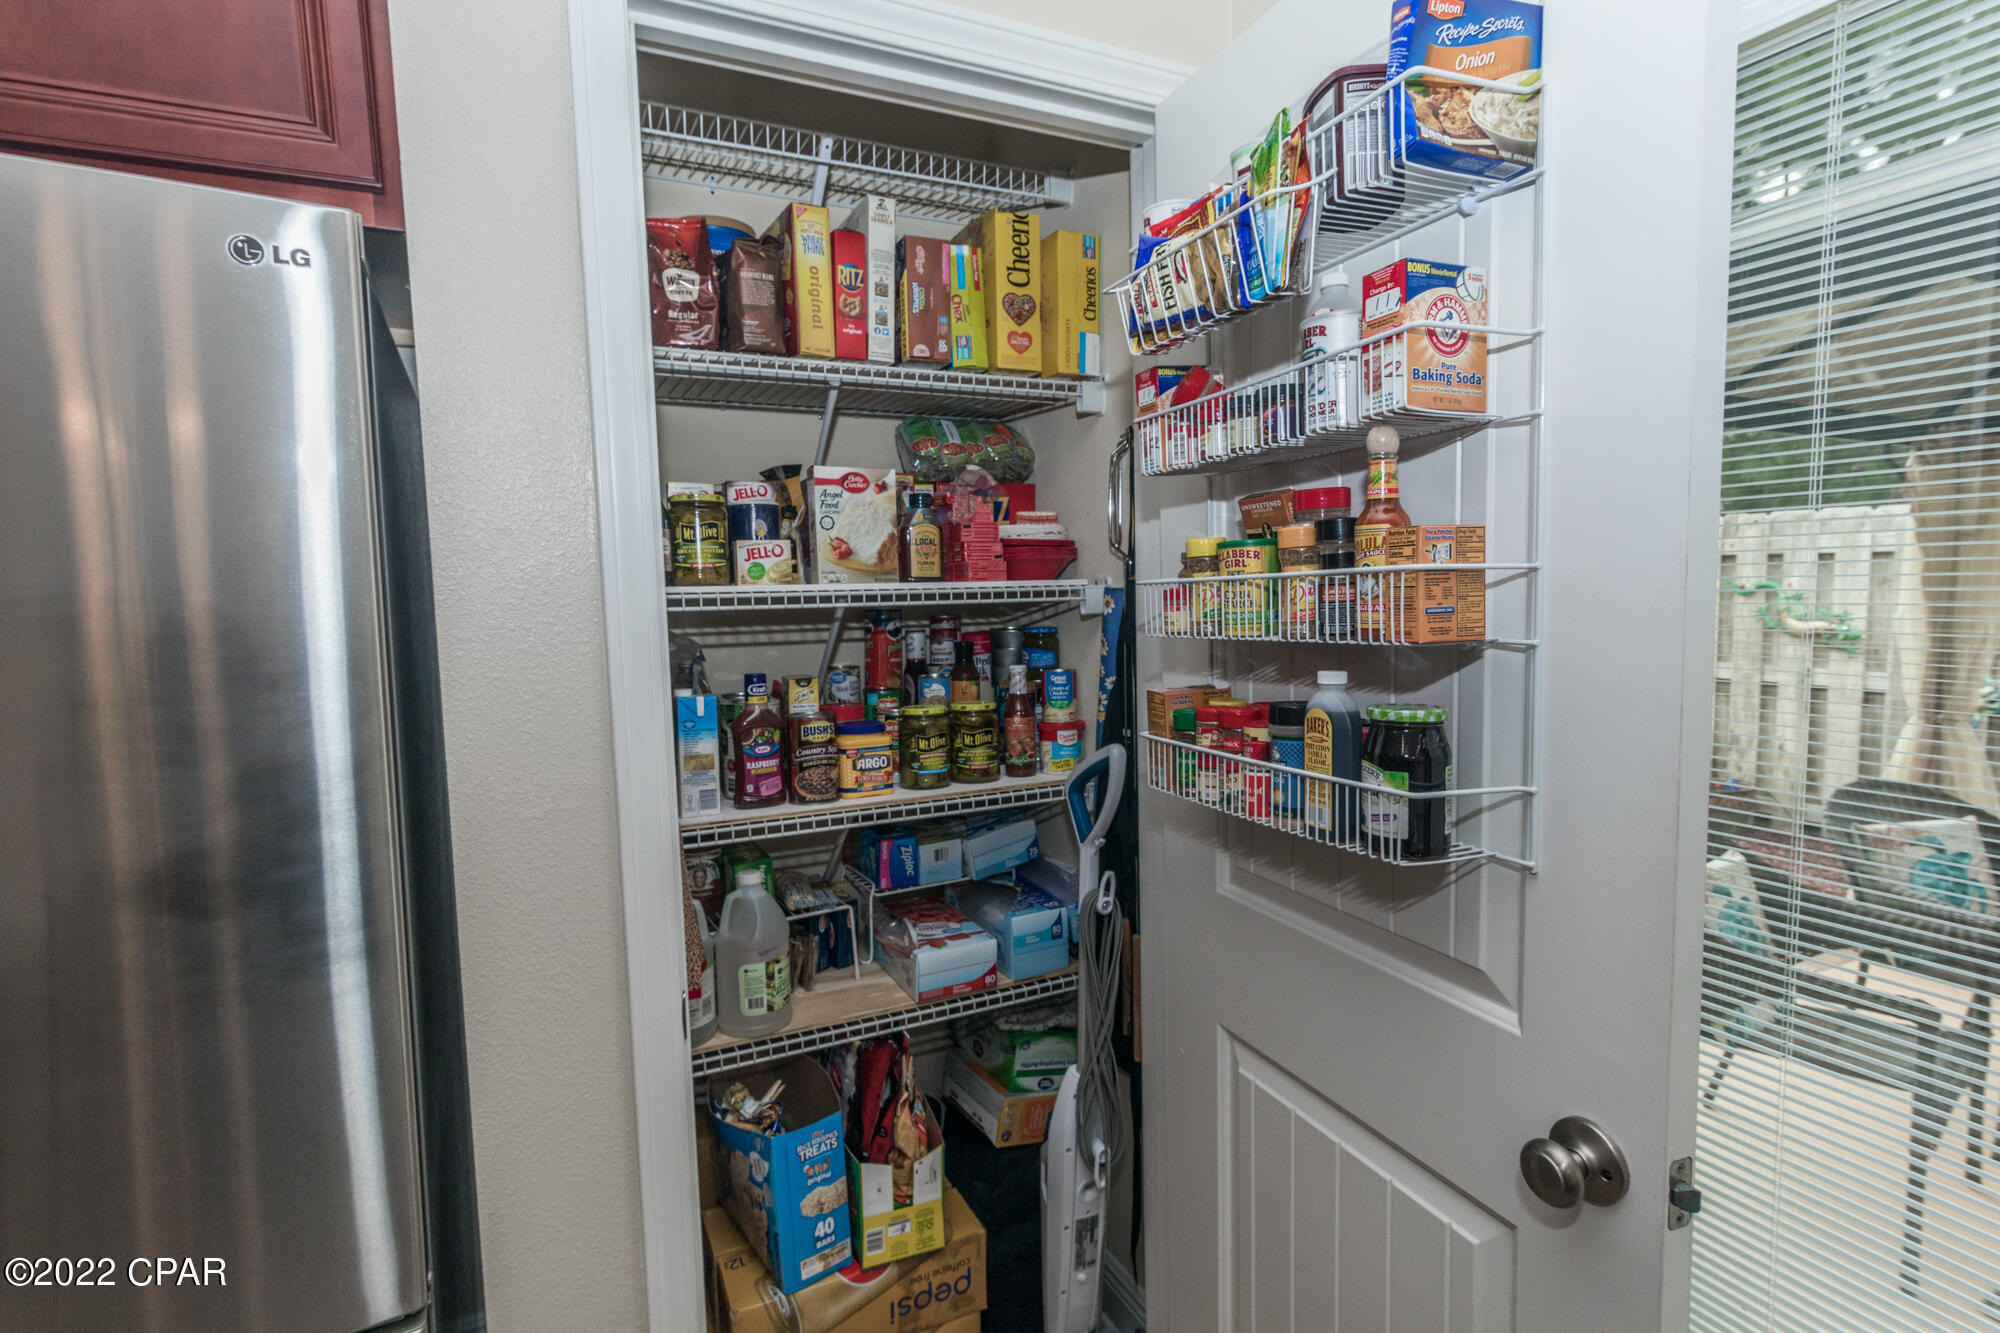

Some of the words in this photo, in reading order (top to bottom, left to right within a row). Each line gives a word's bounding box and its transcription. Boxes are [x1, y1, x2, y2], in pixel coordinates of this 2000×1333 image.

[1430, 0, 1461, 15] Lipton
[1435, 23, 1483, 45] Recipe
[1478, 16, 1525, 38] Secrets
[1455, 51, 1496, 71] Onion
[801, 235, 824, 247] WHEAT
[272, 244, 312, 268] LG
[803, 244, 825, 256] THINS
[1407, 262, 1431, 274] BONUS
[837, 265, 865, 288] RITZ
[809, 265, 825, 330] original
[911, 281, 919, 314] KRISPIES
[1082, 266, 1097, 322] Cheerios
[1159, 274, 1177, 311] FISH
[667, 310, 699, 320] Regular
[951, 294, 964, 323] Chex
[1440, 361, 1457, 372] Pure
[1412, 367, 1453, 387] Baking
[1456, 371, 1482, 386] Soda
[733, 484, 768, 502] JELL-O
[819, 489, 844, 500] Angel
[819, 500, 839, 509] Food
[1240, 499, 1282, 512] UNSWEETENED
[914, 537, 937, 547] LOCAL
[744, 544, 784, 562] JELL-O
[1224, 559, 1248, 569] GIRL
[802, 724, 835, 738] BUSH'S
[1306, 716, 1330, 737] BAKER'S
[918, 738, 930, 751] Mt.
[929, 736, 947, 749] Olive
[964, 734, 975, 746] Mt.
[974, 733, 993, 744] Olive
[1305, 742, 1330, 752] IMITATION
[796, 747, 825, 756] Country
[1307, 750, 1327, 760] VANILLA
[746, 759, 780, 770] RASPBERRY
[856, 756, 888, 770] ARGO
[1307, 757, 1327, 767] FLAVOR
[899, 844, 915, 877] Ziploc
[1052, 924, 1061, 934] 80
[984, 974, 996, 984] 80
[799, 1137, 838, 1162] TREATS
[807, 1171, 832, 1186] Original
[814, 1216, 835, 1239] 40
[816, 1234, 836, 1250] BARS
[932, 1258, 972, 1278] caffeine
[910, 1271, 930, 1286] free
[889, 1267, 972, 1326] pepsi
